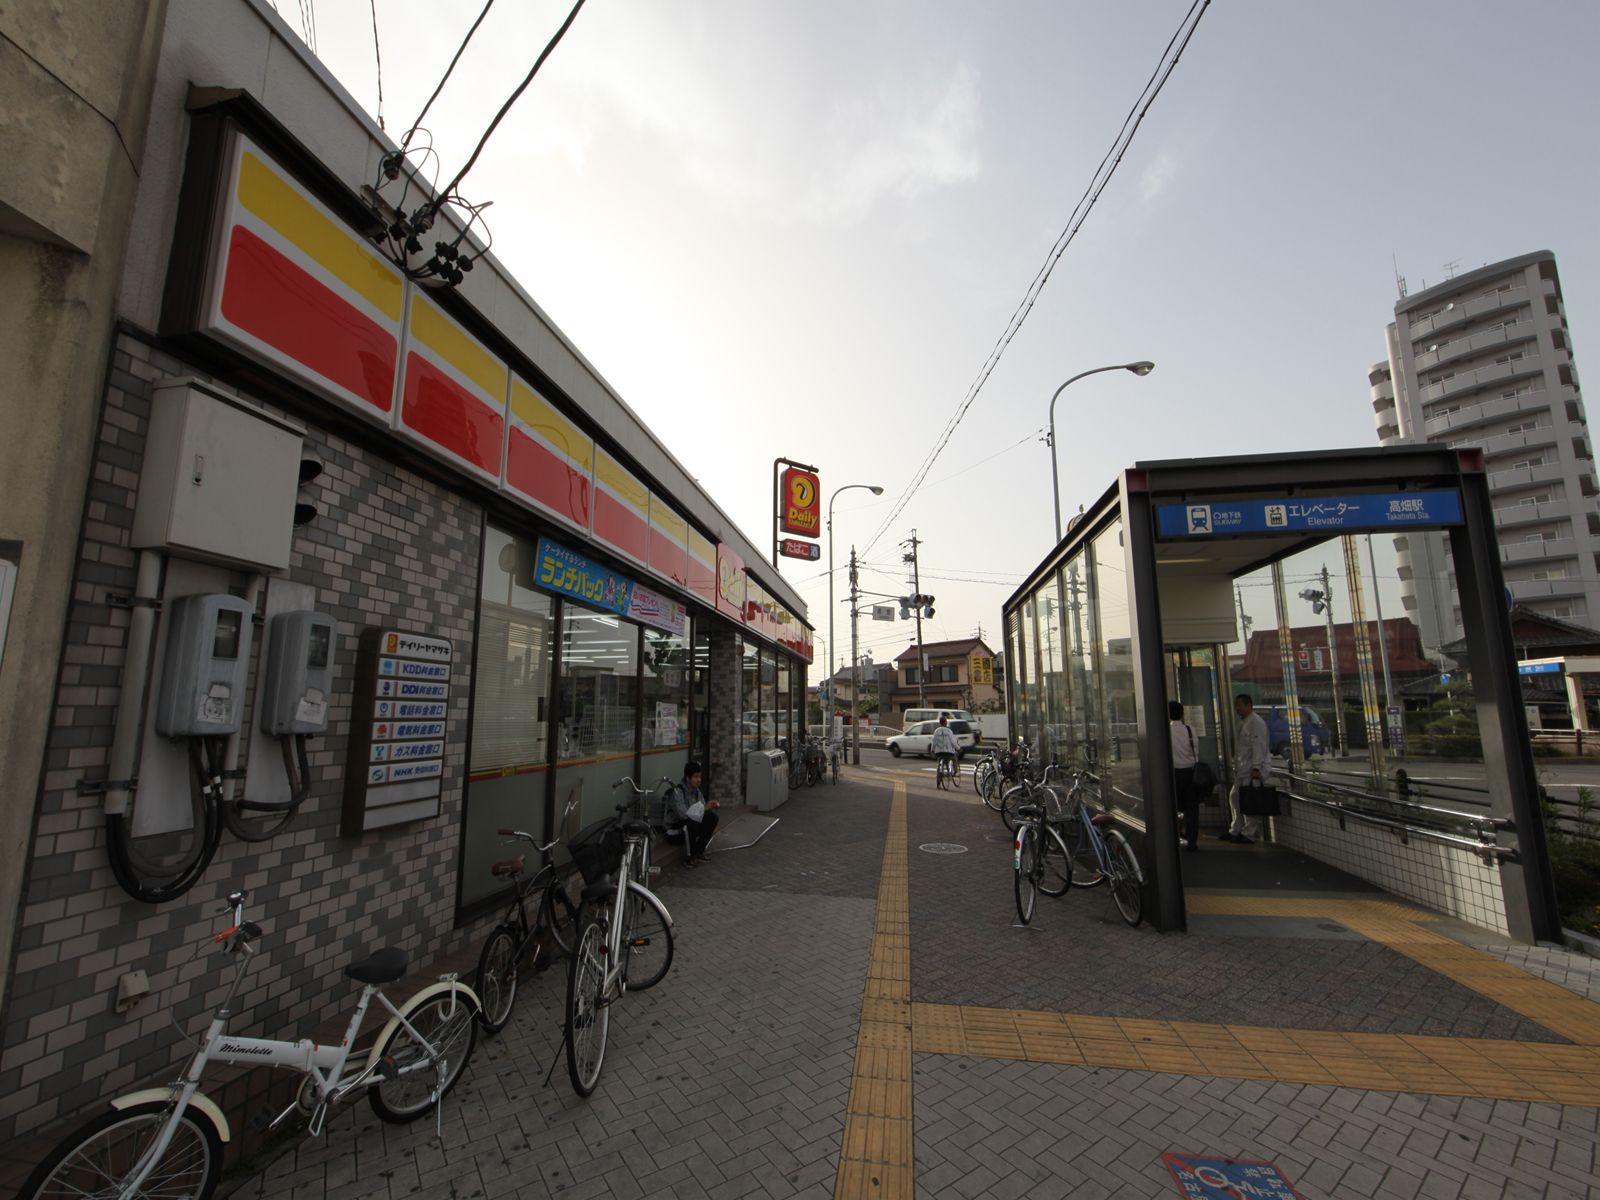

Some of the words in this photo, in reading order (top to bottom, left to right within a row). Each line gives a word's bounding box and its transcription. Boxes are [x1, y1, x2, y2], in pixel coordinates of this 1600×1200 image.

[1288, 502, 1361, 517] エレベーター
[1388, 498, 1425, 513] 高畑駅
[788, 507, 818, 529] Daily
[1307, 517, 1344, 526] Elevator
[786, 541, 809, 556] たばこ
[540, 555, 605, 603] ランチパック
[399, 641, 450, 655] デイリーヤマザキ
[393, 767, 413, 777] NHK
